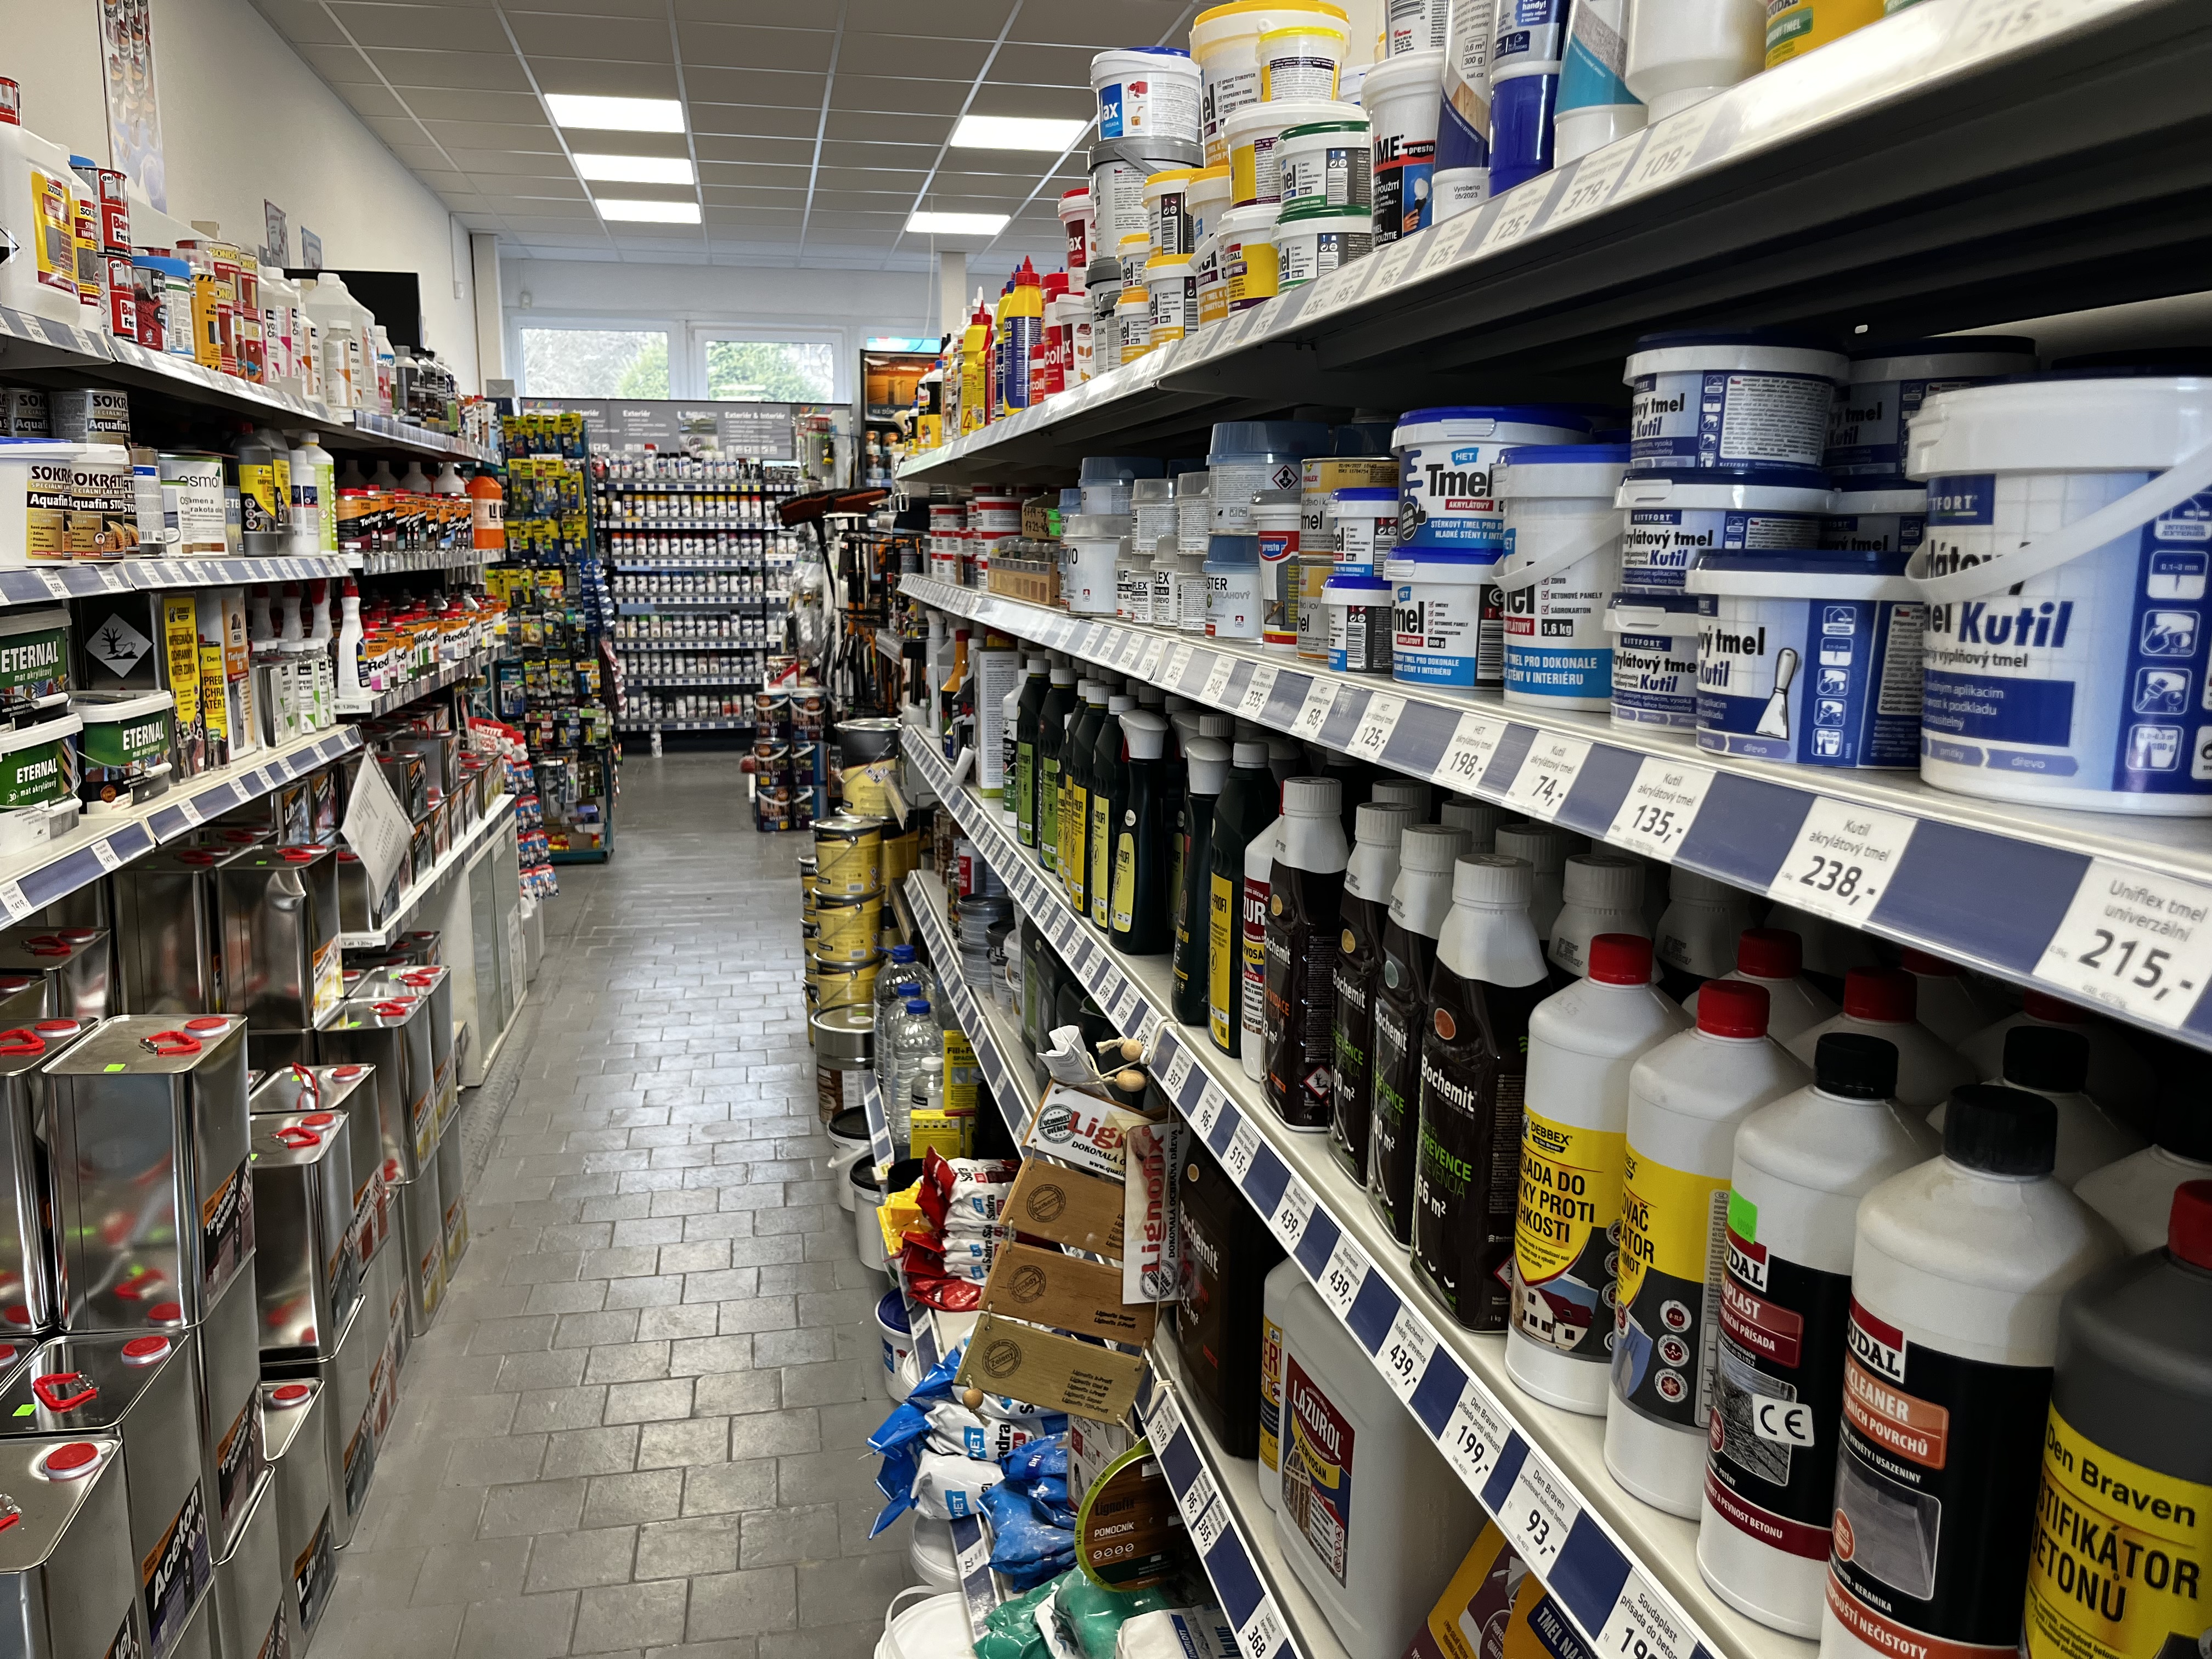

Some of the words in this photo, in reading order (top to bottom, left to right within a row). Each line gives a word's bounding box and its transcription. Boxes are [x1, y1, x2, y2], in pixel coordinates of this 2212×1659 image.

[1522, 1, 1546, 11] handy!
[1466, 71, 1484, 80] bal.cz
[1409, 144, 1434, 155] presto
[1378, 180, 1400, 194] POUŽITÍ
[1454, 184, 1481, 193] Vyrobeno
[1651, 393, 1685, 412] tmel
[89, 419, 127, 433] Aquafin
[1636, 417, 1662, 438] Kutil
[1455, 452, 1475, 462] HET
[1425, 463, 1492, 497] Tmel
[30, 493, 68, 507] Aquafin
[1448, 499, 1490, 510] AKRYLÁTOVÝ
[1431, 517, 1460, 530] STĚRKOVÝ
[1462, 520, 1480, 529] TMEL
[1482, 521, 1496, 530] PRO
[1633, 513, 1671, 522] KITTFORT
[1435, 528, 1458, 539] HLADKÉ
[1460, 528, 1481, 539] STĚNY
[1483, 531, 1487, 539] V
[1674, 529, 1713, 546] tmel
[1262, 543, 1280, 554] presto
[1650, 550, 1688, 566] Kutil
[1211, 590, 1250, 601] PODLAHOVÝ
[1398, 590, 1410, 600] HET
[1550, 590, 1578, 600] BETONOVÉ
[1579, 591, 1602, 600] PANELY
[1550, 605, 1592, 614] SÁDROKARTON
[1543, 621, 1555, 635] 1,6
[1558, 622, 1572, 636] kg
[1958, 601, 2074, 648] Kutil
[1429, 639, 1440, 647] 800
[1623, 636, 1662, 648] KITTFORT
[1716, 627, 1765, 656] tmel
[1, 641, 59, 673] ETERNAL
[1404, 656, 1415, 664] TMEL
[1416, 657, 1426, 665] PRO
[1427, 657, 1459, 667] DOKONALE
[1509, 652, 1523, 667] TMEL
[1524, 654, 1541, 668] PRO
[1542, 656, 1597, 669] DOKONALE
[1939, 651, 1989, 668] výplňový
[1993, 653, 2028, 668] tmel
[14, 673, 26, 682] mat
[1423, 665, 1452, 676] INTERIÉRU
[1508, 665, 1525, 682] STĚNY
[1526, 670, 1532, 683] V
[1533, 670, 1584, 685] INTERIÉRU
[1640, 675, 1678, 693] Kutil
[1954, 684, 2004, 699] aplikacím
[1306, 708, 1323, 730] 68,-
[1949, 701, 1997, 716] podkladu
[123, 720, 164, 751] ETERNAL
[1360, 726, 1386, 751] 125,-
[1455, 734, 1481, 751] akrylátový
[1480, 741, 1494, 751] tmel
[1550, 745, 1566, 757] Kutil
[16, 758, 58, 785] ETERNAL
[1449, 751, 1483, 780] 198,-
[1530, 755, 1560, 774] akrylátový
[1560, 763, 1575, 775] tmel
[20, 788, 31, 797] mat
[32, 779, 57, 795] akrylátový
[1532, 775, 1564, 807] 74,-
[1662, 772, 1683, 787] Kutil
[1637, 783, 1675, 805] akrylátový
[1675, 793, 1695, 807] tmel
[1632, 804, 1683, 843] 135,-
[1843, 819, 1871, 837] Kutil
[1808, 830, 1863, 859] akrylátový
[1864, 843, 1892, 862] tmel
[1799, 854, 1876, 907] 238,-
[2109, 880, 2165, 911] Uniflex
[2166, 896, 2208, 923] tmel
[2104, 902, 2193, 942] univerzální
[2078, 928, 2193, 1002] 215,-
[1333, 967, 1366, 1009] Bochemit
[1374, 1002, 1407, 1052] Bochemit
[1421, 1053, 1475, 1113] Bochemit
[1200, 1109, 1212, 1131] 96,-
[1531, 1120, 1571, 1146] DEBBEX
[1071, 1141, 1119, 1165] DOKONALÁ
[1229, 1146, 1247, 1176] 515,-
[1169, 1164, 1178, 1207] OCHRANA
[1558, 1172, 1585, 1196] DO
[1141, 1134, 1165, 1273] Lignofix
[1431, 1195, 1447, 1218] m²
[1539, 1192, 1595, 1223] PROTI
[1168, 1209, 1177, 1259] DOKONALÁ
[1179, 1198, 1219, 1274] Bochemit
[1279, 1209, 1301, 1241] 439,-
[1328, 1268, 1352, 1305] 439,-
[1404, 1318, 1425, 1346] Bochemit
[1740, 1320, 1776, 1353] PŘÍSADA
[1407, 1338, 1427, 1364] prevence
[1389, 1342, 1417, 1386] 439,-
[1293, 1379, 1342, 1461] LAZUROL
[1470, 1397, 1482, 1411] Den
[1480, 1407, 1499, 1434] Braven
[1869, 1415, 1929, 1457] POVRCHŮ
[1298, 1435, 1328, 1481] ČERVOSAN
[1455, 1424, 1489, 1475] 199,-
[1718, 1467, 1736, 1487] POTĚRY
[1876, 1456, 1921, 1484] USAZENINY
[2047, 1423, 2074, 1473] Den
[2080, 1457, 2197, 1528] Braven
[1533, 1469, 1545, 1485] Den
[1544, 1480, 1565, 1512] Braven
[1093, 1521, 1135, 1538] POMOCNÍK
[1717, 1497, 1721, 1508] A
[1722, 1498, 1749, 1531] PEVNOST
[1749, 1513, 1784, 1541] BETONU
[1525, 1508, 1556, 1555] 93,-
[154, 1486, 200, 1611] Aceton
[1854, 1582, 1892, 1613] KERAMIKA
[1537, 1606, 1560, 1641] TMEL
[1620, 1595, 1645, 1628] přísada
[1638, 1592, 1678, 1643] Soudaplast
[1859, 1618, 1928, 1659] NEČISTOTY
